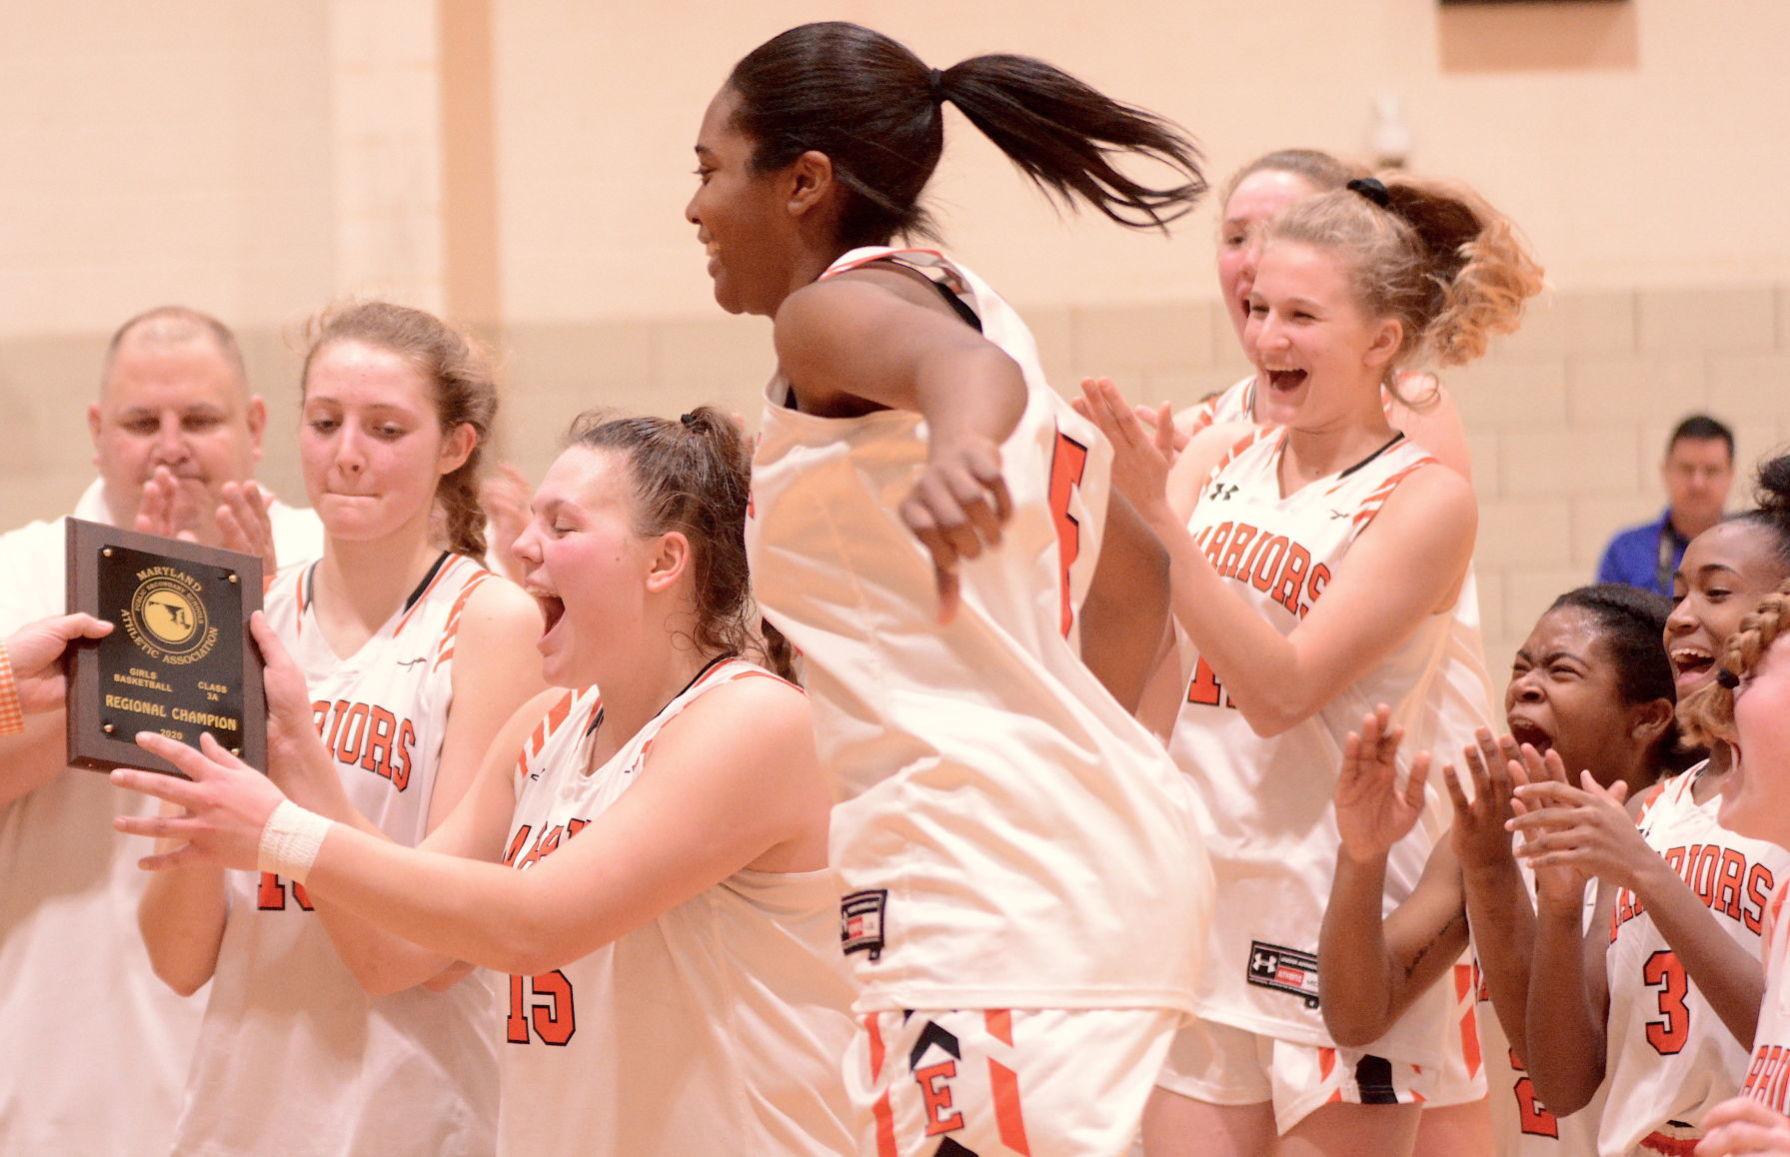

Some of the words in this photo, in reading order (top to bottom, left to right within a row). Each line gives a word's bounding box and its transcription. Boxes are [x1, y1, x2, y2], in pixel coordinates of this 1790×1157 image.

[136, 566, 202, 592] MARYLAND
[120, 608, 160, 659] ATHLETIC
[162, 626, 219, 665] ASSOCIATION
[113, 673, 173, 693] BASKETBALL
[129, 667, 158, 680] GIRLS
[197, 681, 228, 694] CLASS
[206, 692, 219, 701] 3A
[105, 694, 167, 718] REGIONAL
[171, 707, 237, 731] CHAMPION
[160, 728, 183, 740] 2020
[507, 969, 576, 1046] 15
[1643, 949, 1690, 1056] 3
[915, 1059, 965, 1138] E
